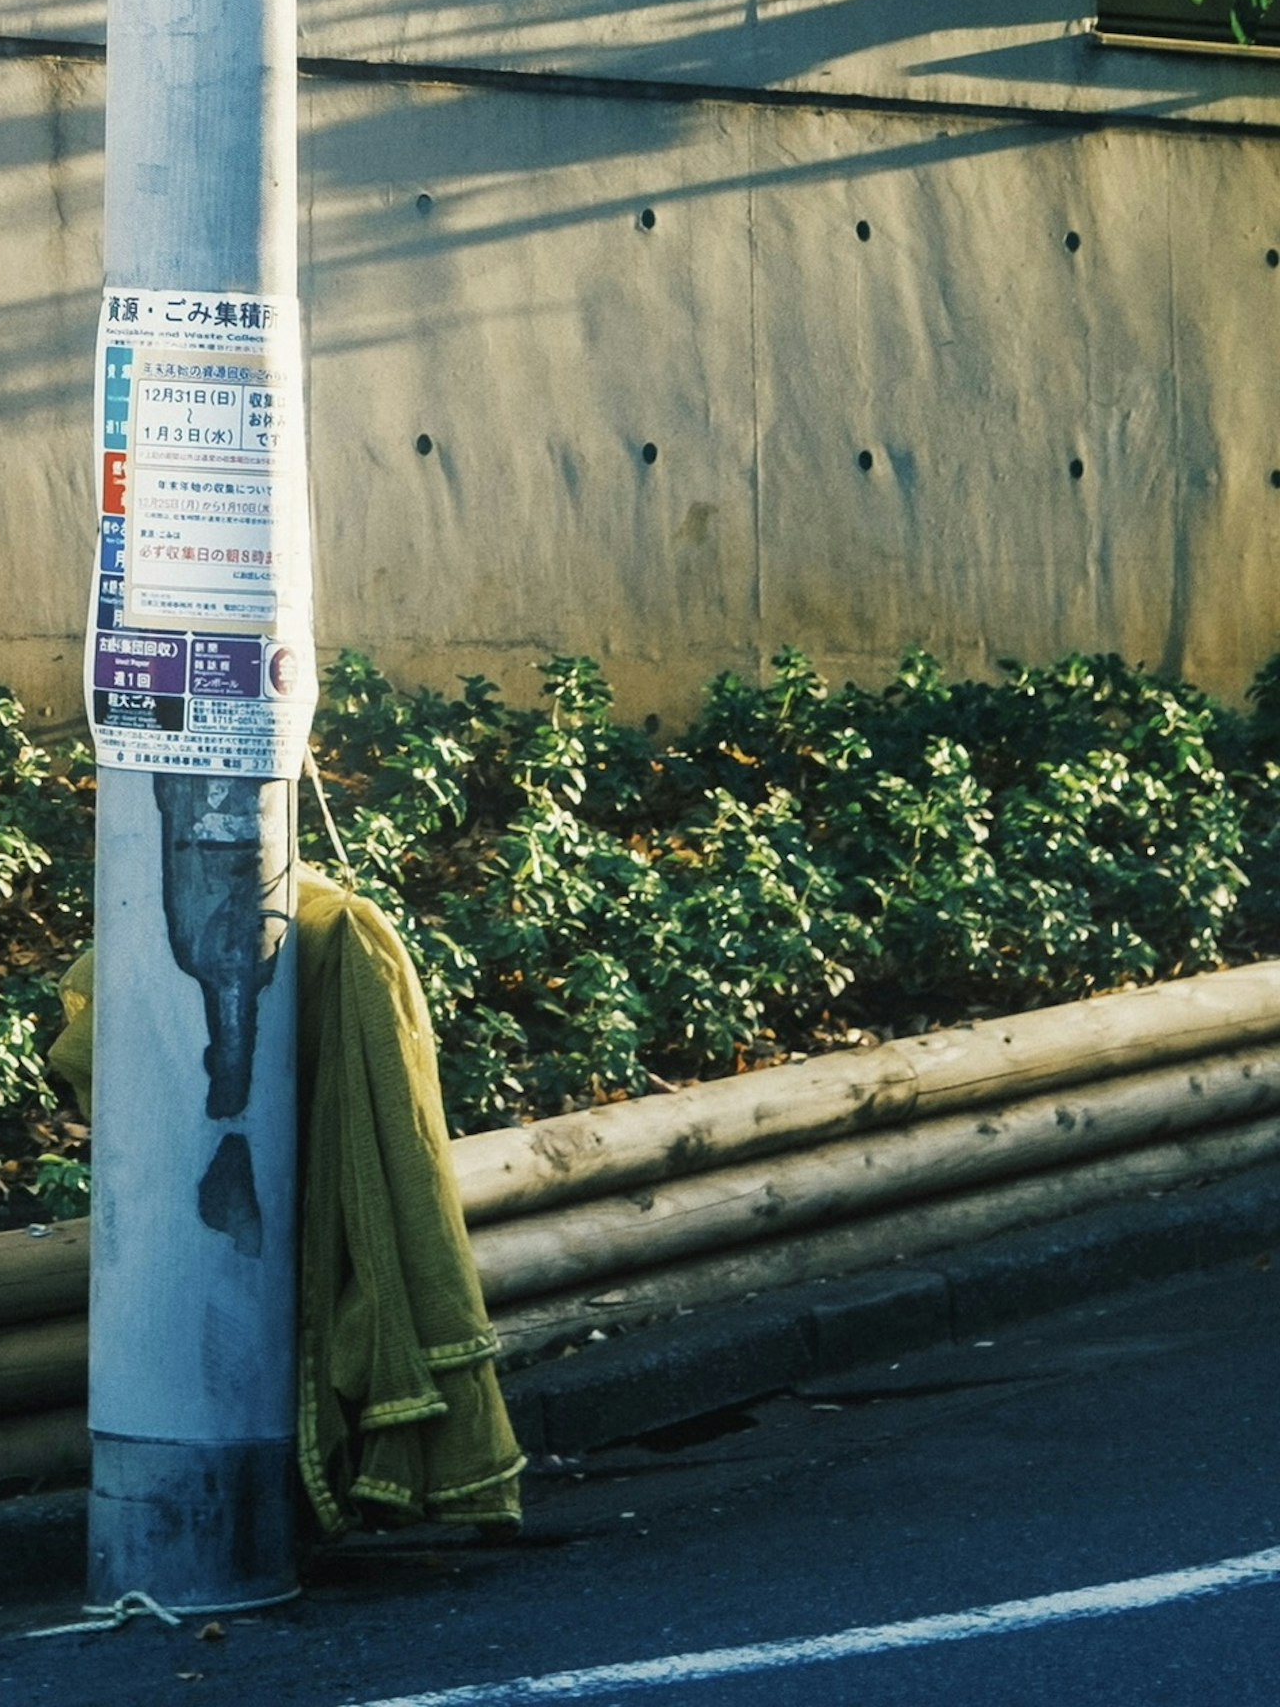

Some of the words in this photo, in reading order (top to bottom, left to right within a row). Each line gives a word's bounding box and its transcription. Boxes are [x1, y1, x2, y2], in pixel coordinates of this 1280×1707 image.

[108, 296, 279, 330] 資源・ごみ集積所
[184, 331, 224, 340] Waste
[144, 388, 237, 407] 12月31日(日)
[113, 671, 151, 689] 週1回
